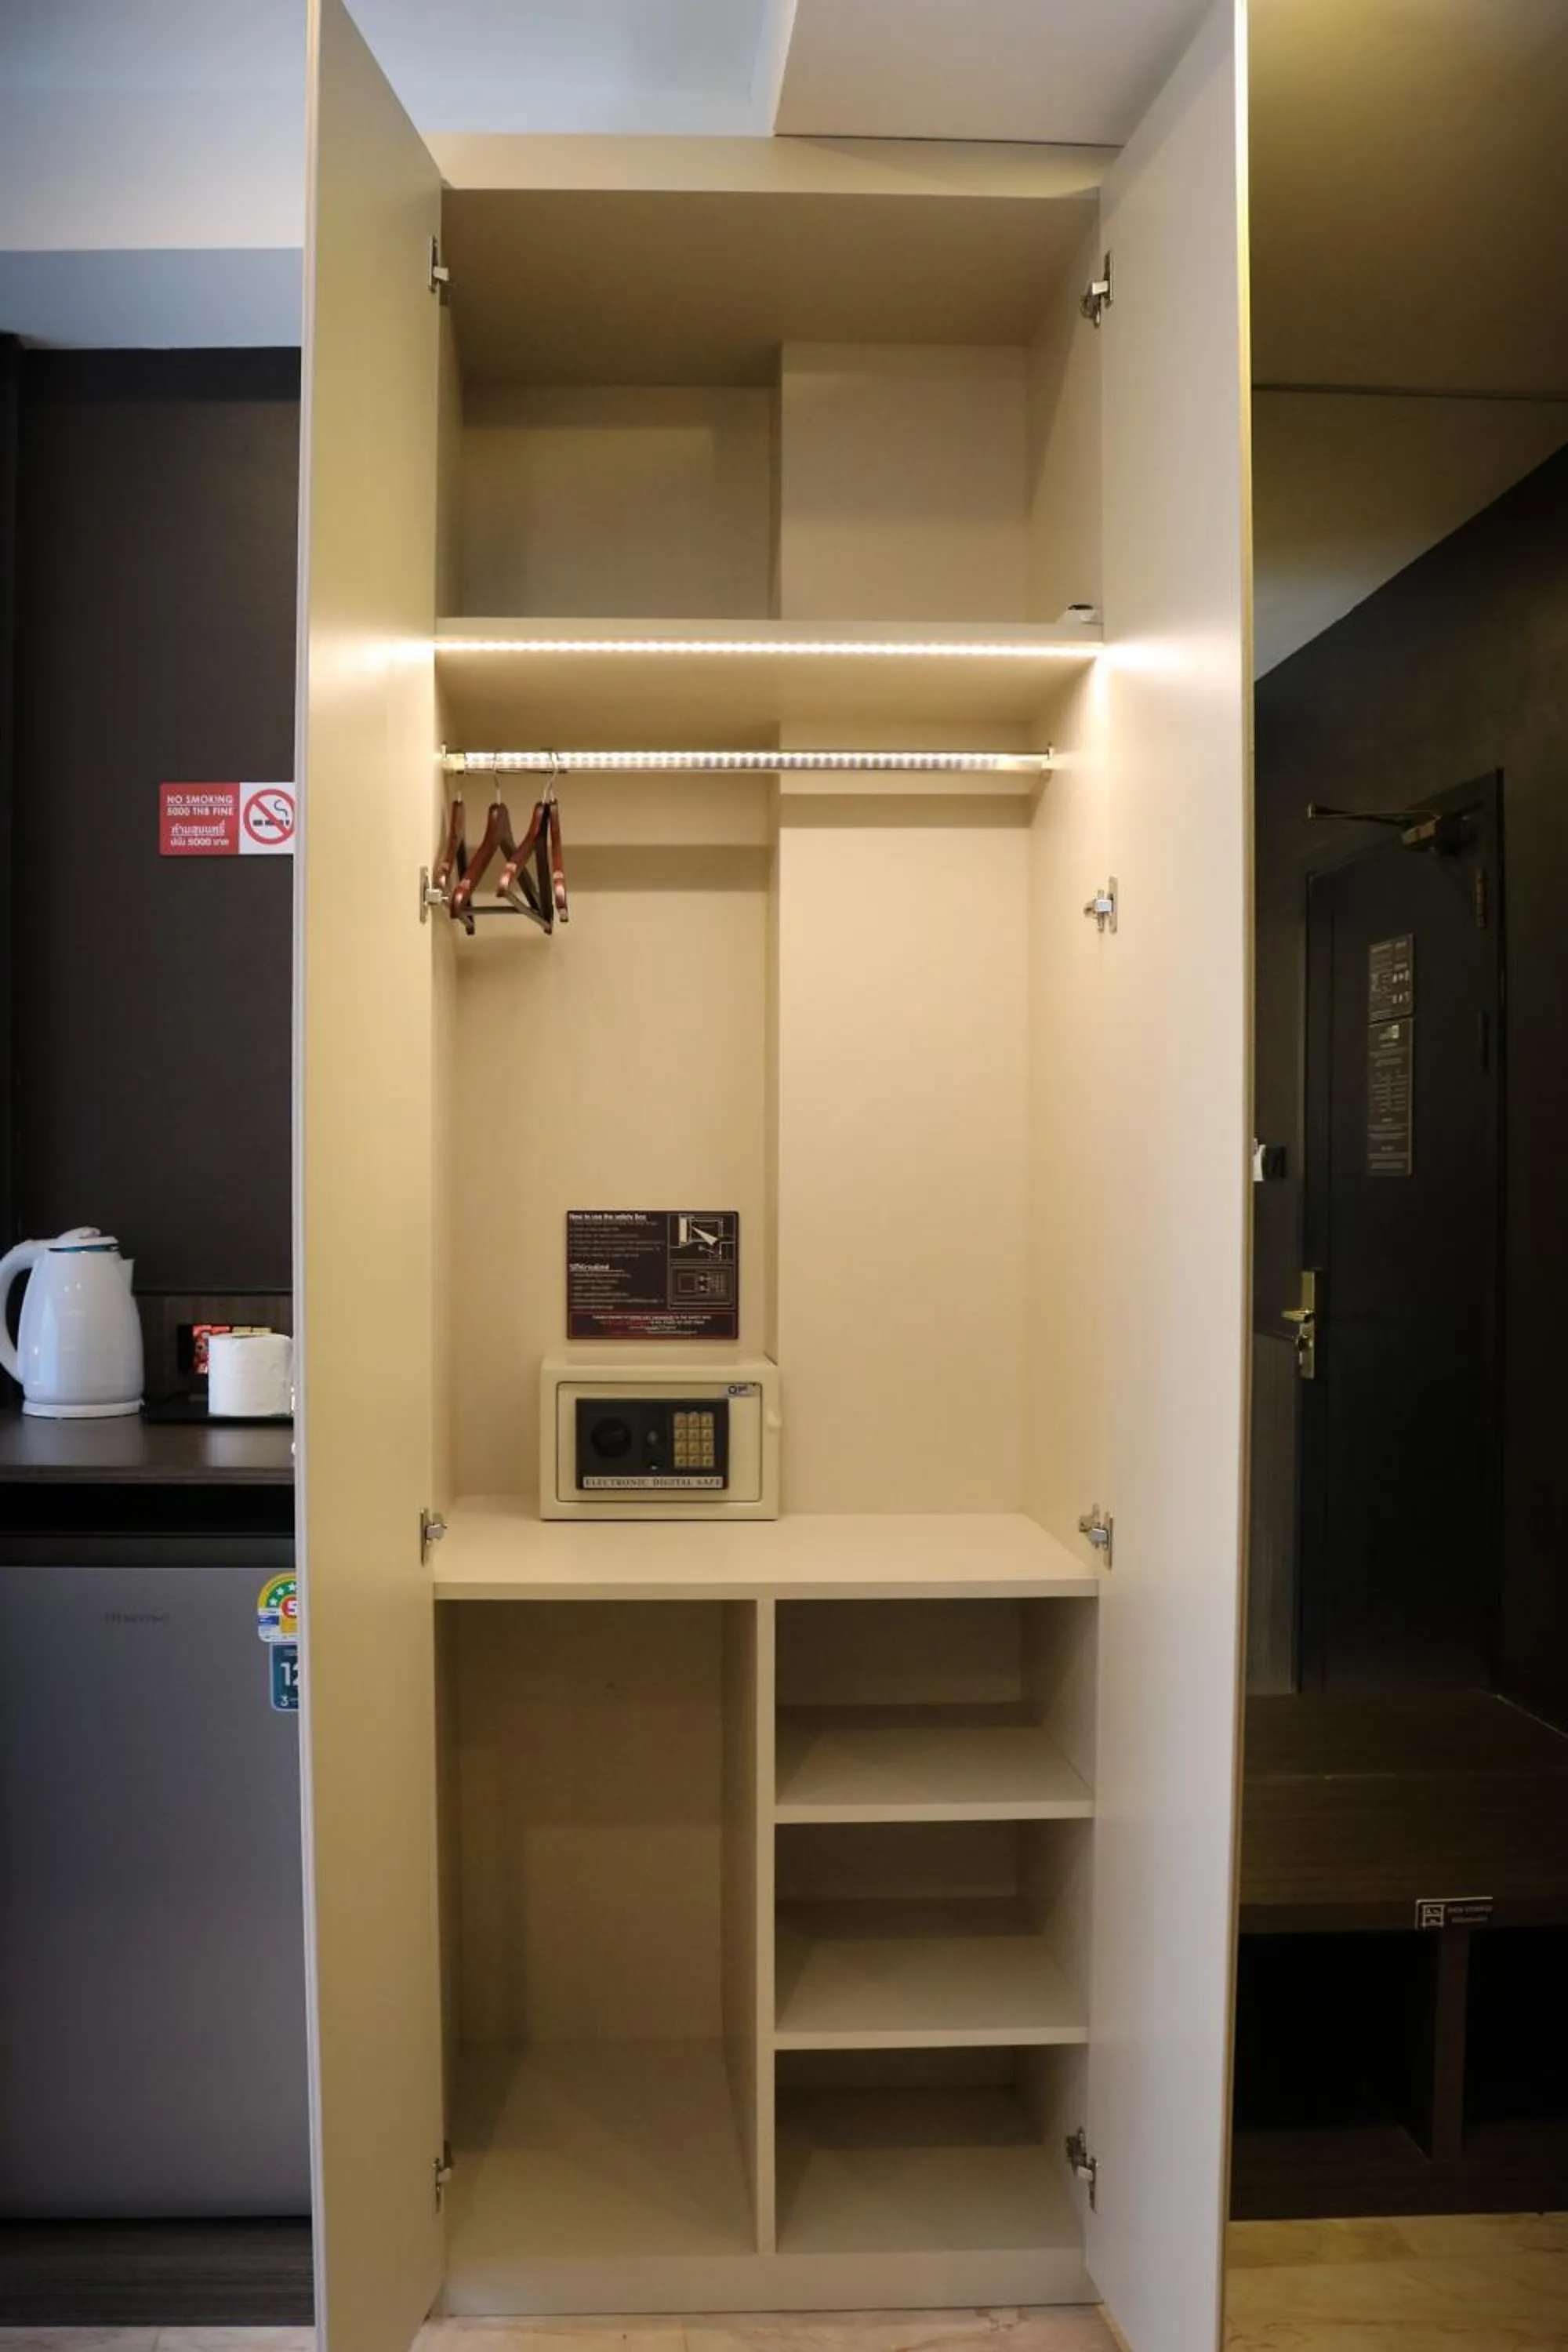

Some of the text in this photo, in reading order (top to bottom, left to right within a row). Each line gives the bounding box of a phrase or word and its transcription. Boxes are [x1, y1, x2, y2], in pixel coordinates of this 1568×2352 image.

[167, 794, 233, 804] NO SMOKING
[212, 807, 234, 816] FINE
[586, 1478, 648, 1487] ELECTRONIC
[653, 1478, 691, 1487] DIGITAL
